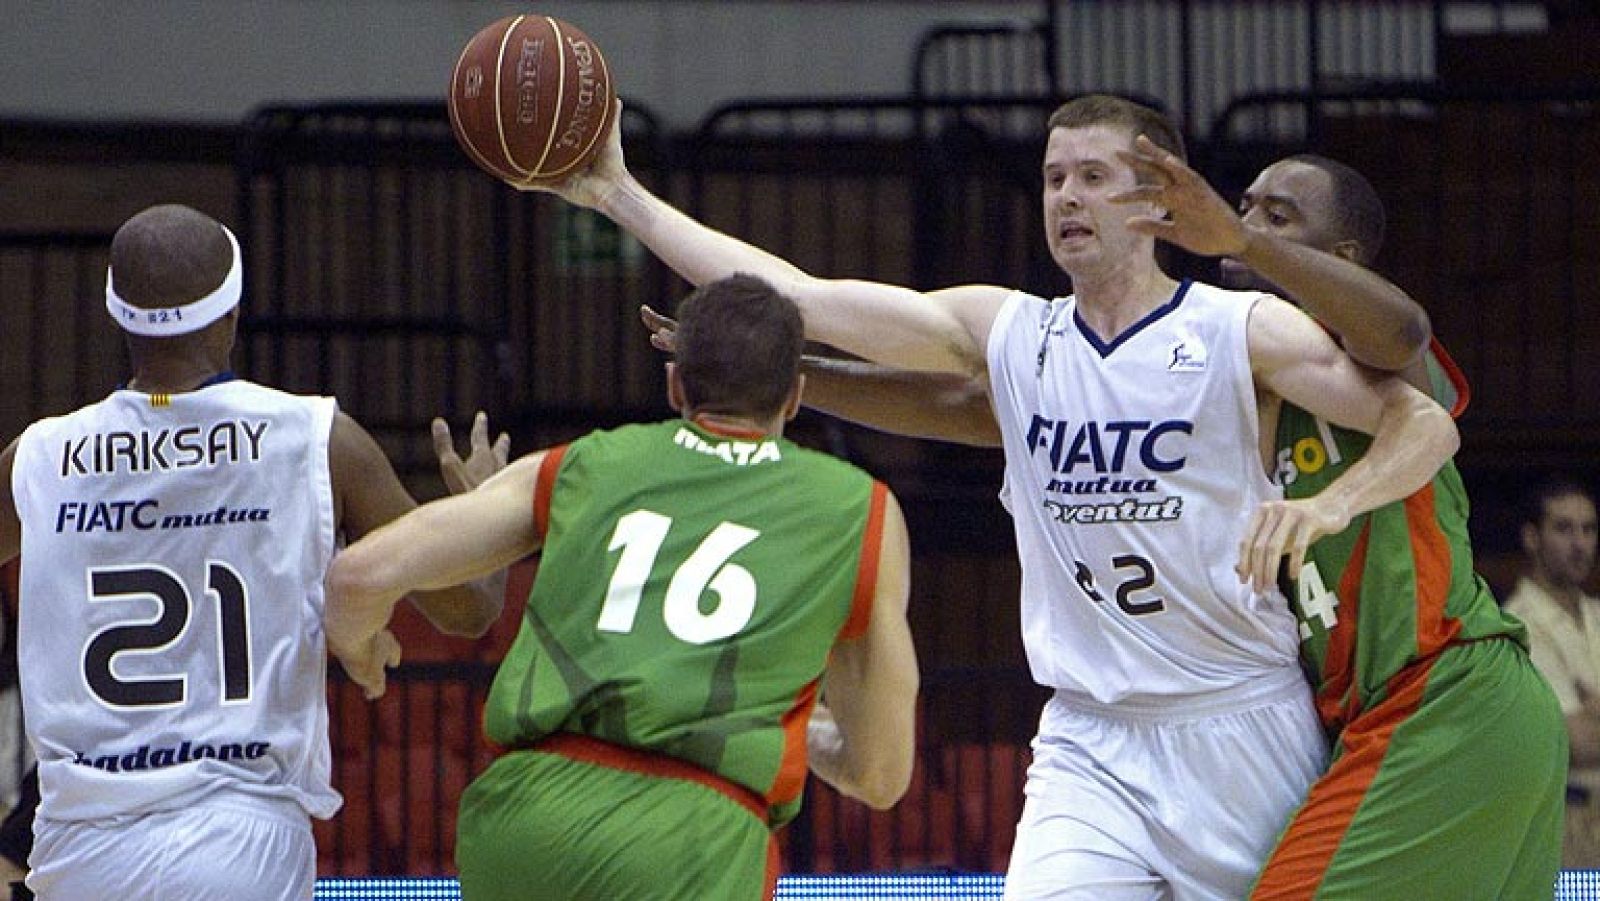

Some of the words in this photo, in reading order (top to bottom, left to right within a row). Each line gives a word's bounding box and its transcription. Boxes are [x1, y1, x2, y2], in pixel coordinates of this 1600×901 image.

[60, 418, 269, 477] KIRKSAY
[1026, 414, 1194, 474] FIATC
[55, 499, 159, 532] FIATC
[161, 507, 270, 529] mutua
[597, 508, 761, 645] 16
[1300, 560, 1339, 640] 4
[81, 560, 252, 711] 21
